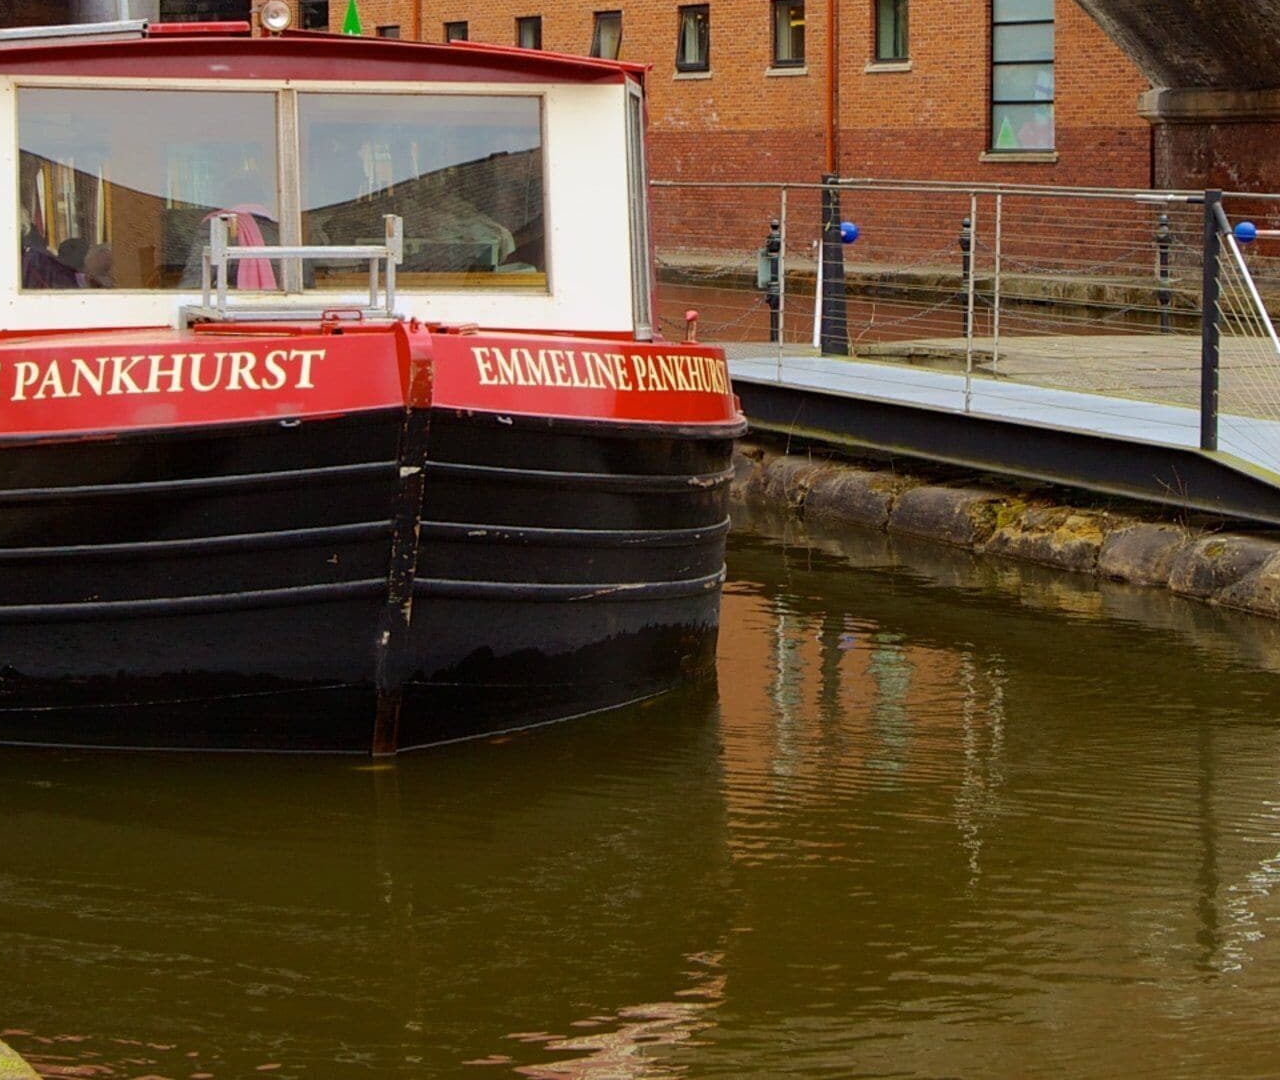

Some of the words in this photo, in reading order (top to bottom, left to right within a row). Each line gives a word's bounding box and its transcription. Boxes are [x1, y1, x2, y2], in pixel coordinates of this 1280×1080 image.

[10, 349, 327, 401] PANKHURST
[470, 346, 632, 392] EMMELINE
[631, 354, 730, 396] PANKHURST
